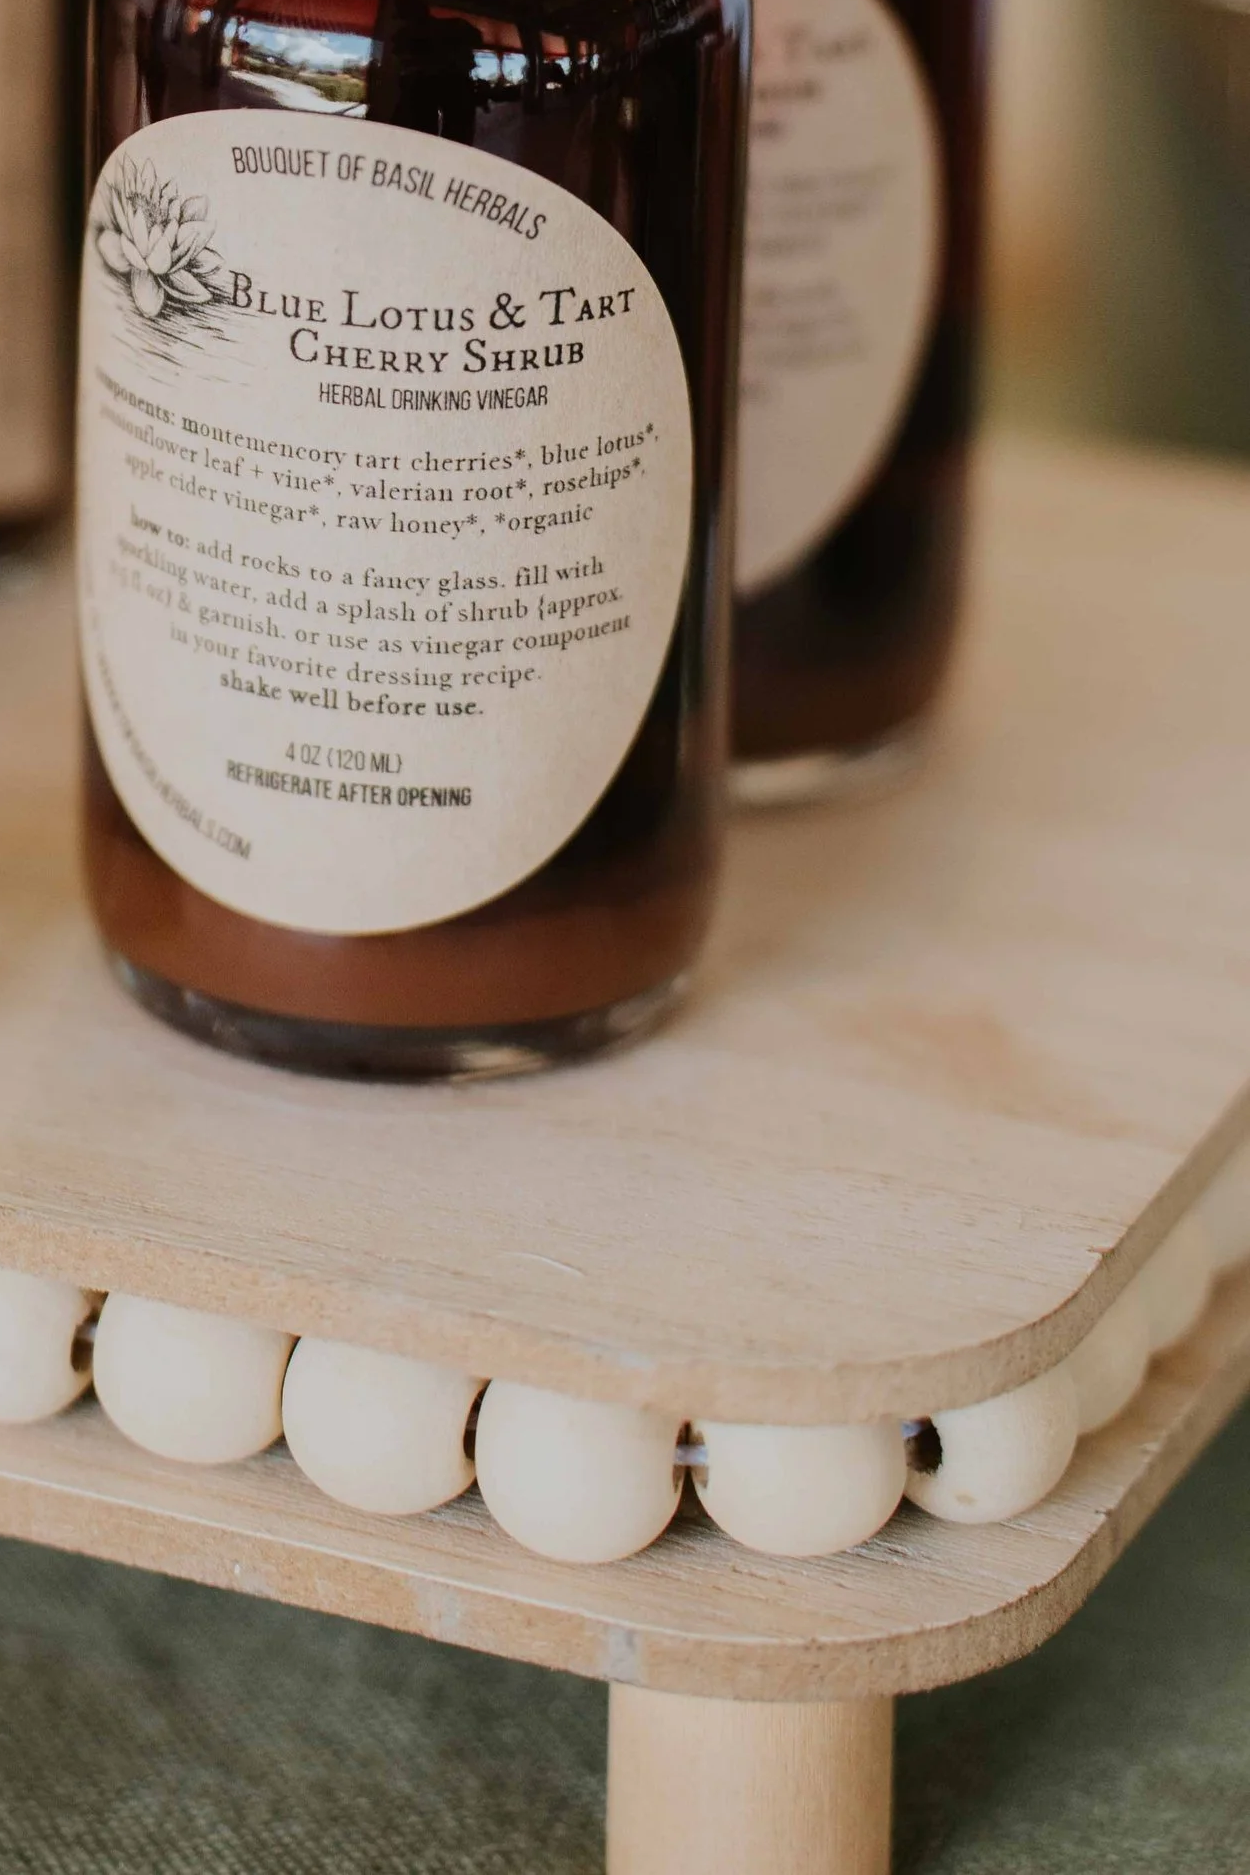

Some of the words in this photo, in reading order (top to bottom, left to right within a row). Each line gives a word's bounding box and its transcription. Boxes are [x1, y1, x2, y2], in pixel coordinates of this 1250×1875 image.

[231, 146, 332, 179] BOUQUET
[337, 153, 366, 181] OF
[371, 159, 443, 200] BASIL
[443, 177, 547, 240] HERBALS
[488, 292, 526, 330] &
[95, 365, 175, 425] ponents:
[182, 415, 347, 471] montemencory
[355, 452, 401, 471] tart
[541, 443, 589, 466] blue
[319, 382, 387, 409] HERBAL
[391, 387, 471, 411] DRINKING
[477, 385, 549, 411] VINEGAR
[100, 403, 198, 463] ionflower
[204, 447, 245, 477] leaf
[250, 463, 264, 478] +
[350, 479, 453, 502] valerian
[169, 469, 218, 502] cider
[336, 514, 383, 531] raw
[117, 533, 188, 586] arkling
[193, 569, 258, 604] water,
[266, 588, 307, 612] add
[316, 599, 328, 615] a
[337, 597, 416, 624] splash
[425, 601, 453, 623] of
[457, 599, 529, 623] shrub
[130, 502, 161, 536] how
[167, 528, 190, 548] to:
[196, 539, 233, 565] add
[241, 555, 301, 578] rocks
[310, 566, 332, 583] to
[342, 573, 353, 587] a
[362, 568, 430, 596] fancy
[438, 571, 506, 597] glass.
[515, 565, 548, 588] fill
[554, 556, 604, 582] with
[170, 621, 188, 645] in
[194, 634, 240, 660] your
[248, 645, 337, 680] favorite
[347, 661, 453, 692] dressing
[461, 665, 542, 690] recipe.
[178, 591, 192, 614] &
[295, 628, 320, 646] or
[327, 633, 368, 653] use
[378, 639, 403, 654] as
[411, 636, 504, 660] vinegar
[512, 615, 632, 653] component
[220, 669, 282, 701] shake
[289, 688, 339, 711] well
[348, 694, 427, 717] before
[435, 699, 484, 717] use.
[227, 759, 332, 800] REFRIGERATE
[337, 782, 392, 806] AFTER
[397, 786, 472, 808] OPENING
[285, 741, 296, 762] 4
[301, 743, 322, 767] OZ
